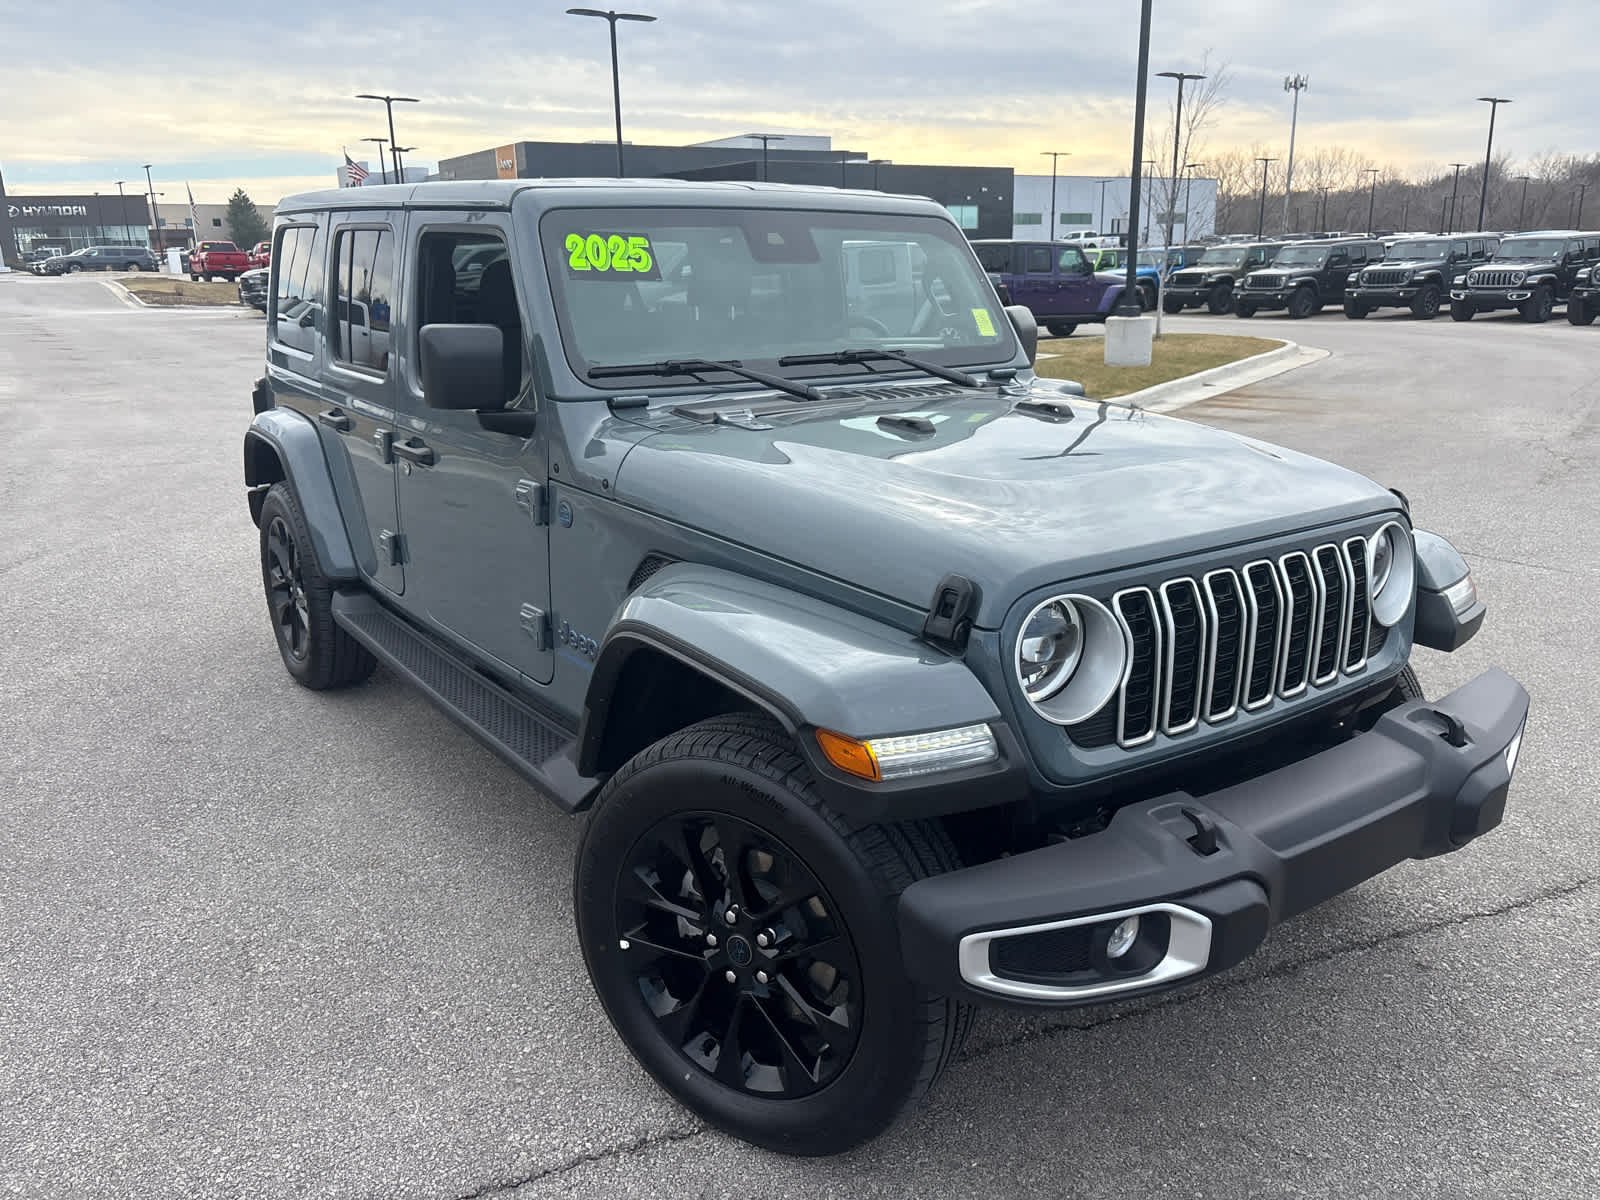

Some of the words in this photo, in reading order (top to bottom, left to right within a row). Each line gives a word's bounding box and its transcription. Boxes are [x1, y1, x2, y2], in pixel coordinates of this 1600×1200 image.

[22, 205, 87, 216] HYUNDAI
[565, 233, 652, 272] 2025
[557, 619, 599, 663] Jeep
